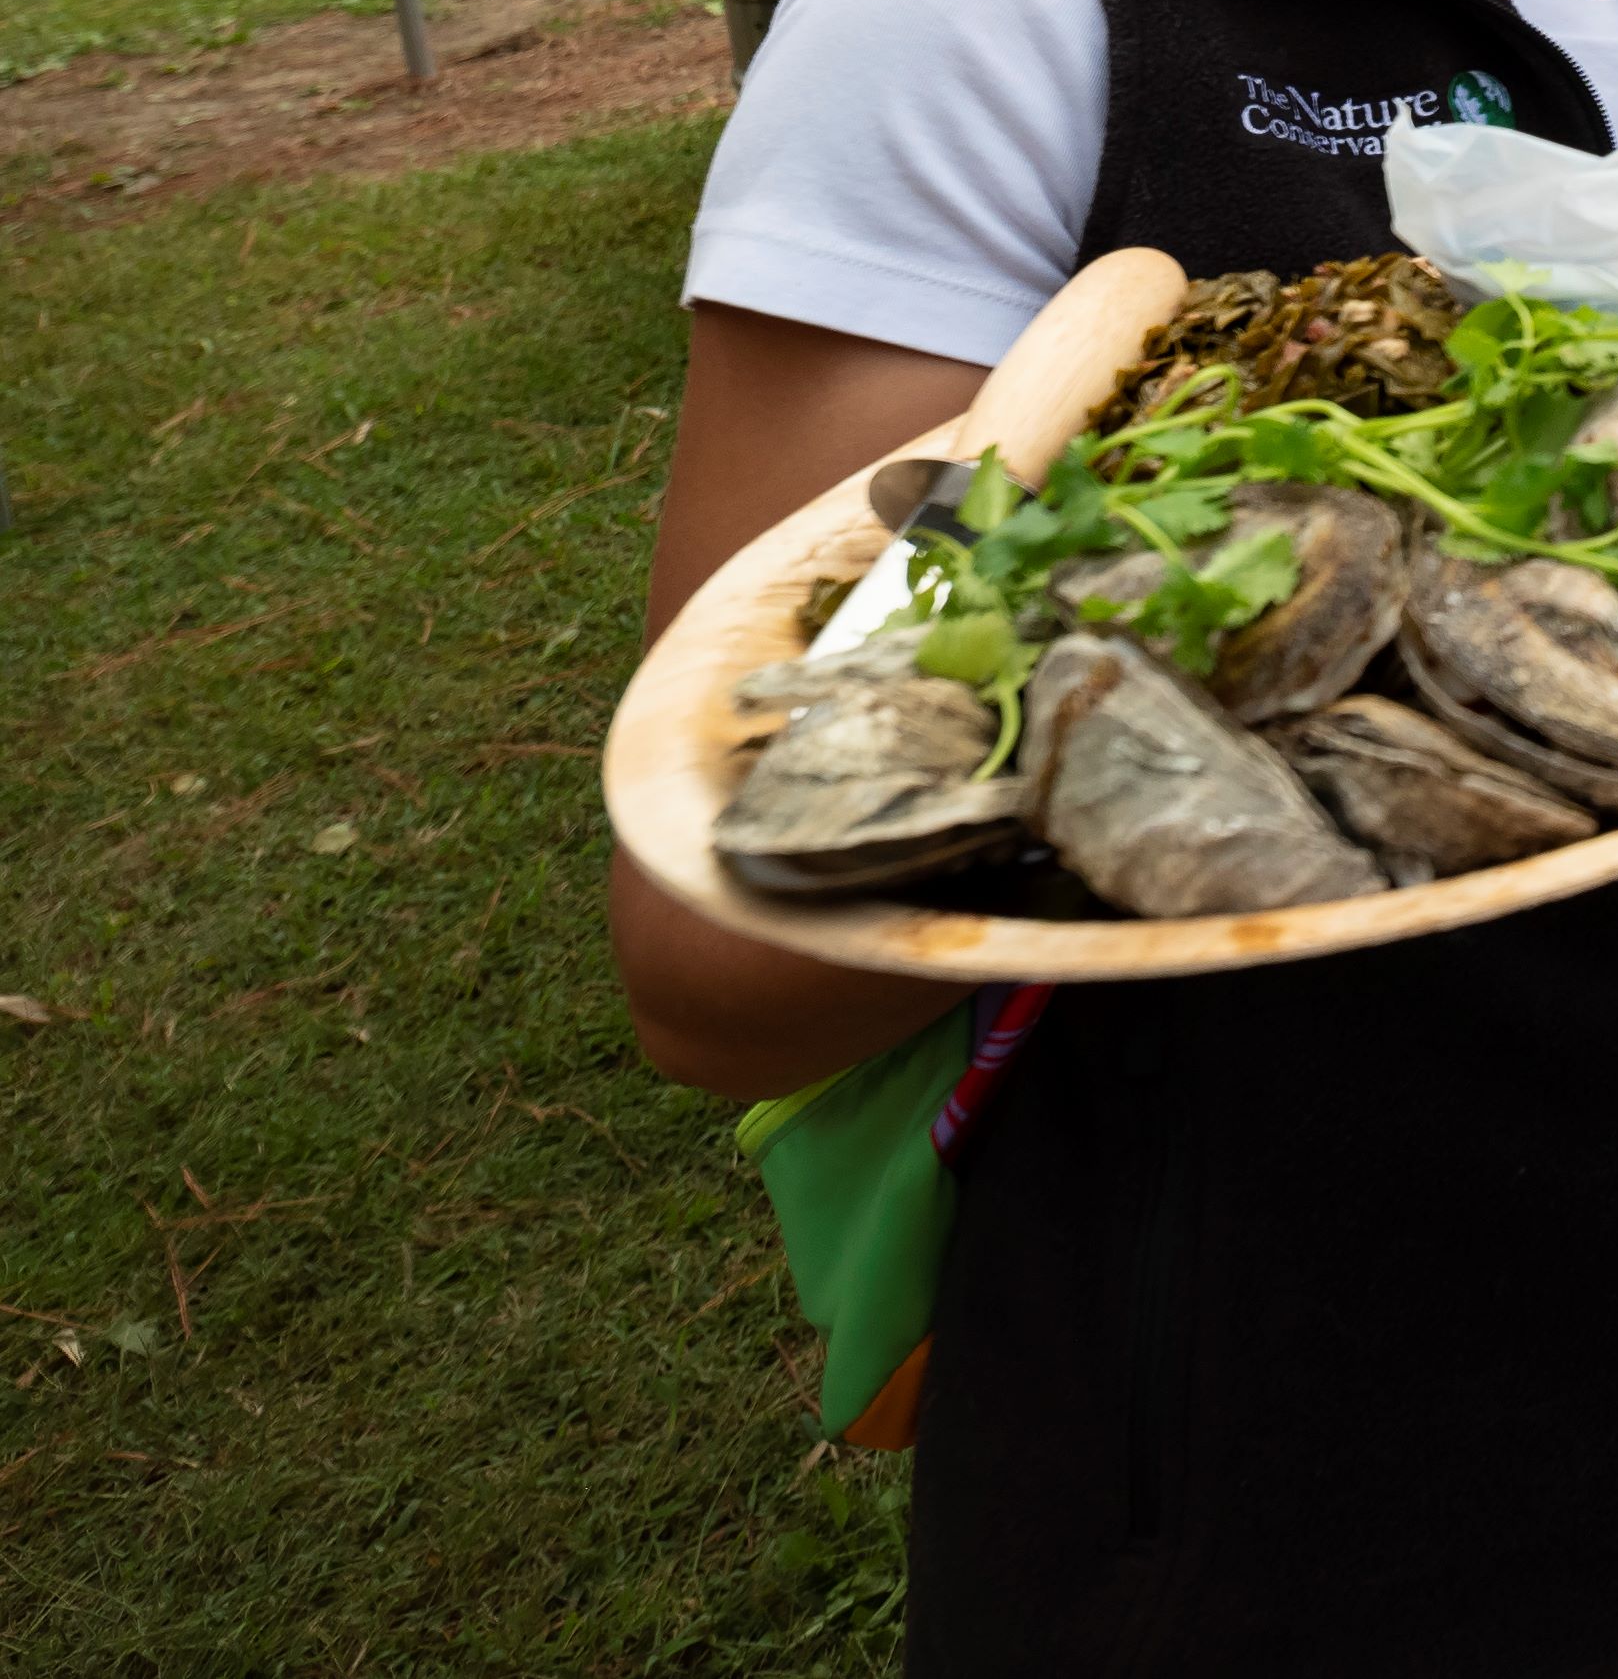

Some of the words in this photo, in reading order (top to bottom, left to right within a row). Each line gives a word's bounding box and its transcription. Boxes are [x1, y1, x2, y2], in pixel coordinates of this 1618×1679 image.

[1238, 73, 1292, 111] The
[1285, 85, 1440, 132] Nature
[1240, 103, 1410, 156] Conserva
